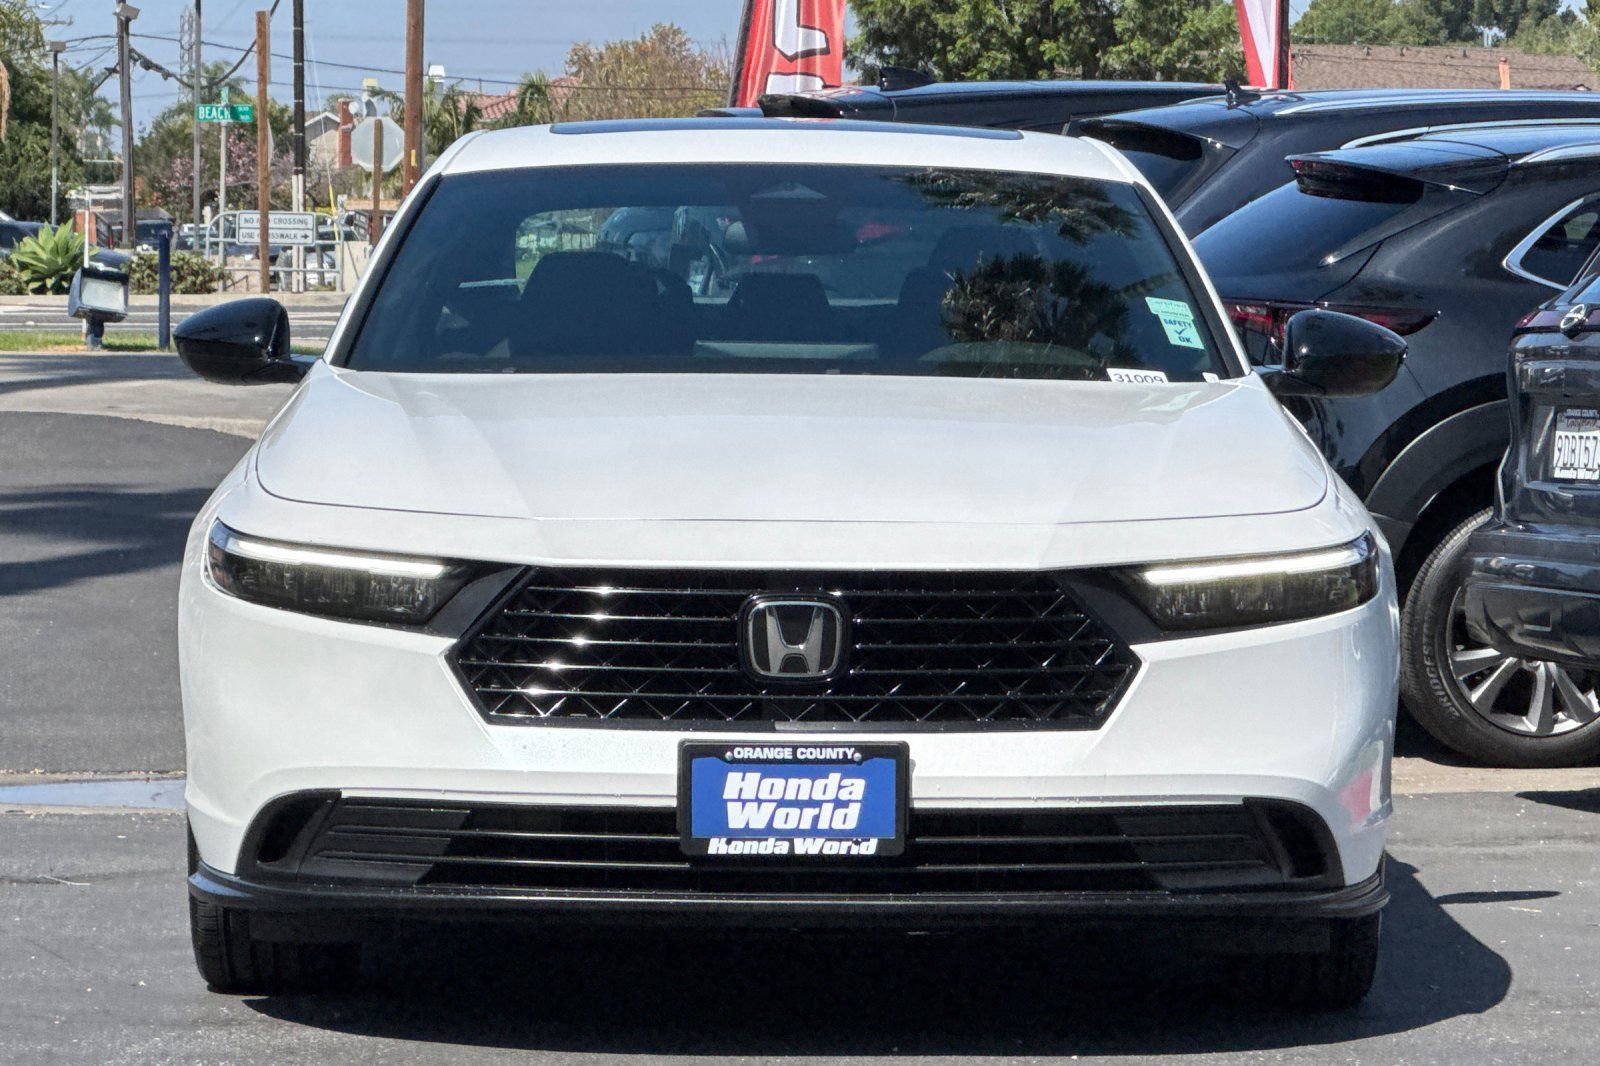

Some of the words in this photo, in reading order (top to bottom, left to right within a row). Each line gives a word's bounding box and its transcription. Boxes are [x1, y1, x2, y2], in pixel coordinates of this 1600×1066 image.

[199, 106, 231, 119] BEACH
[243, 217, 255, 225] NO
[273, 217, 309, 225] CROSSING
[241, 231, 255, 239] USE
[1163, 318, 1192, 328] SAFETY
[1179, 336, 1193, 344] OK
[1113, 373, 1164, 383] 31009
[1556, 434, 1600, 467] 9DBT57
[734, 747, 793, 760] ORANGE
[796, 747, 855, 760] COUNTY
[722, 771, 866, 801] Honda
[726, 801, 861, 830] World
[707, 838, 790, 855] Honda
[793, 838, 878, 855] World
